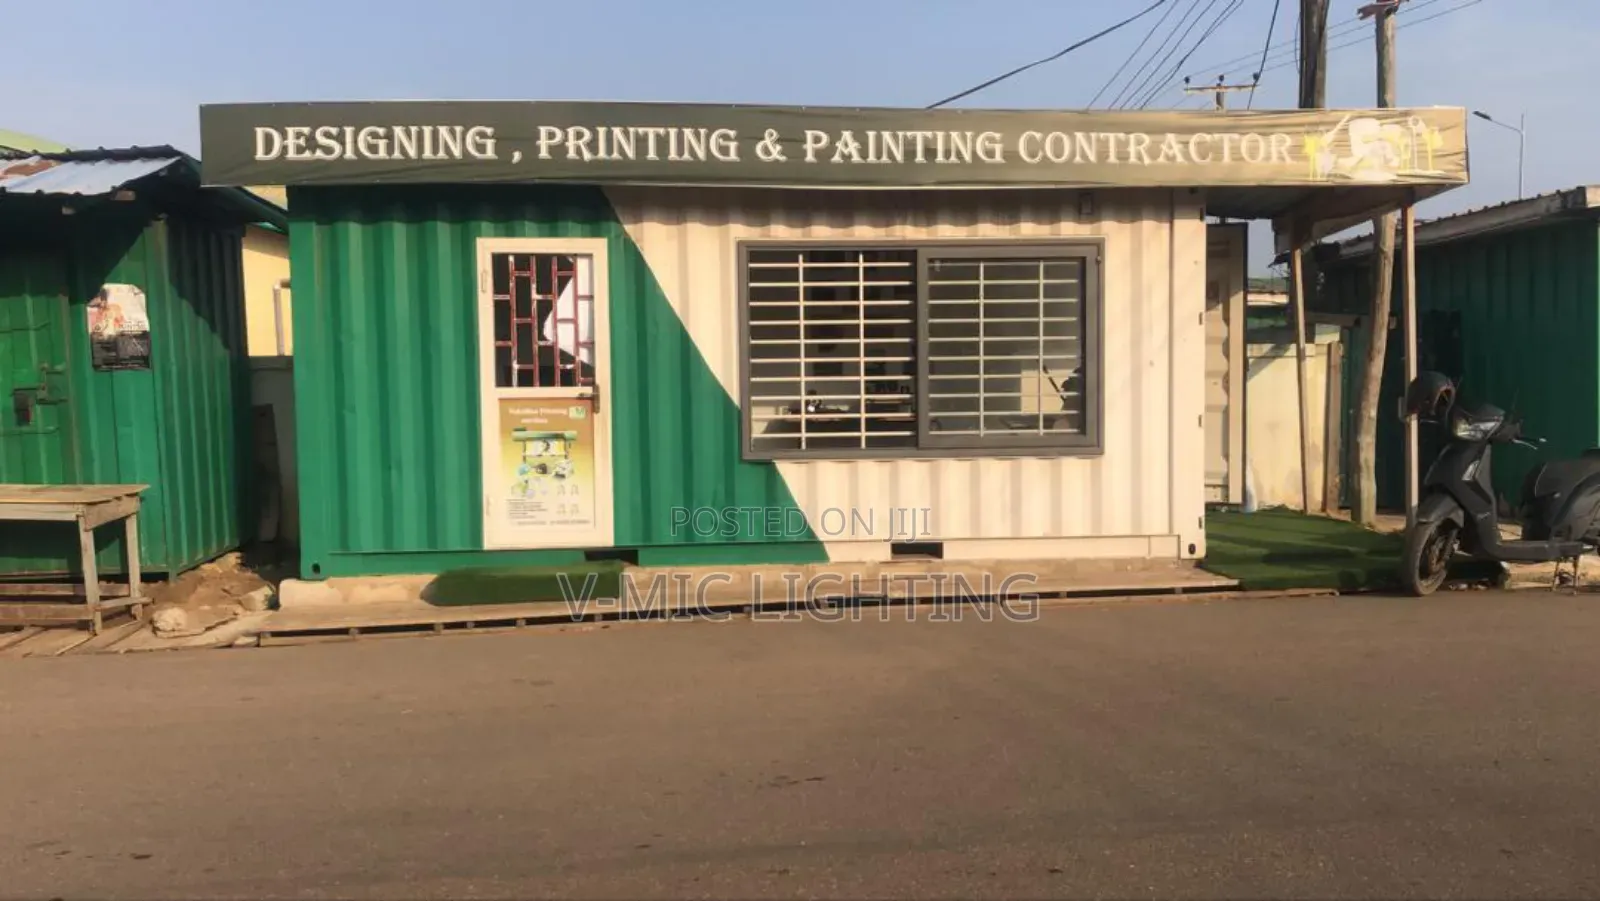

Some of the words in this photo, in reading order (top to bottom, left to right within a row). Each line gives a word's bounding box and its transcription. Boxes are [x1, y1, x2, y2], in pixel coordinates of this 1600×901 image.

[254, 126, 498, 161] DESIGNING
[511, 148, 523, 164] ,
[536, 126, 740, 162] PRINTING
[755, 128, 787, 161] &
[803, 129, 1005, 164] PAINTING
[1017, 131, 1293, 166] CONTRACTOR
